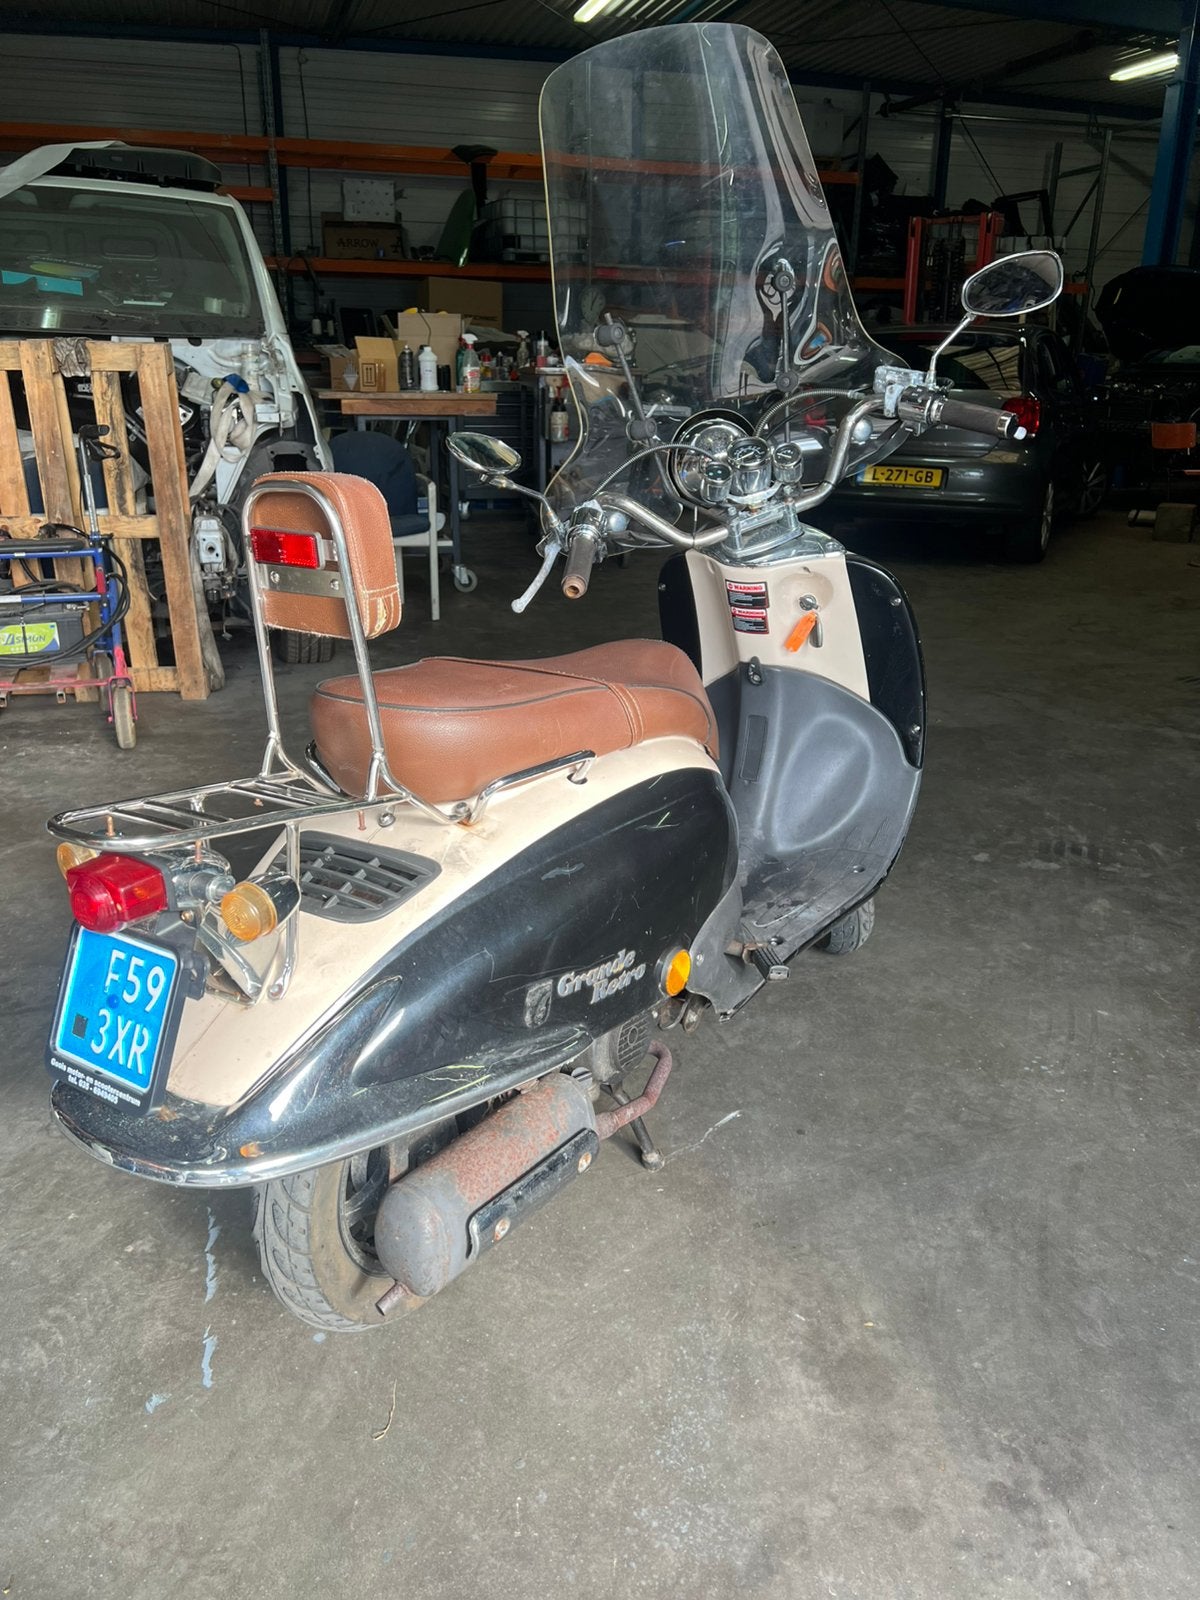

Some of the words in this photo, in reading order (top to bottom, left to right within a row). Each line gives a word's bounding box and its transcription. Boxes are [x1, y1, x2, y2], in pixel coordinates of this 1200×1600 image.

[336, 237, 379, 249] ARROW
[871, 468, 934, 484] L-271-GB
[104, 948, 166, 1012] F59
[557, 948, 636, 997] Grande
[590, 963, 646, 1005] Retro
[90, 1008, 150, 1075] 3XR
